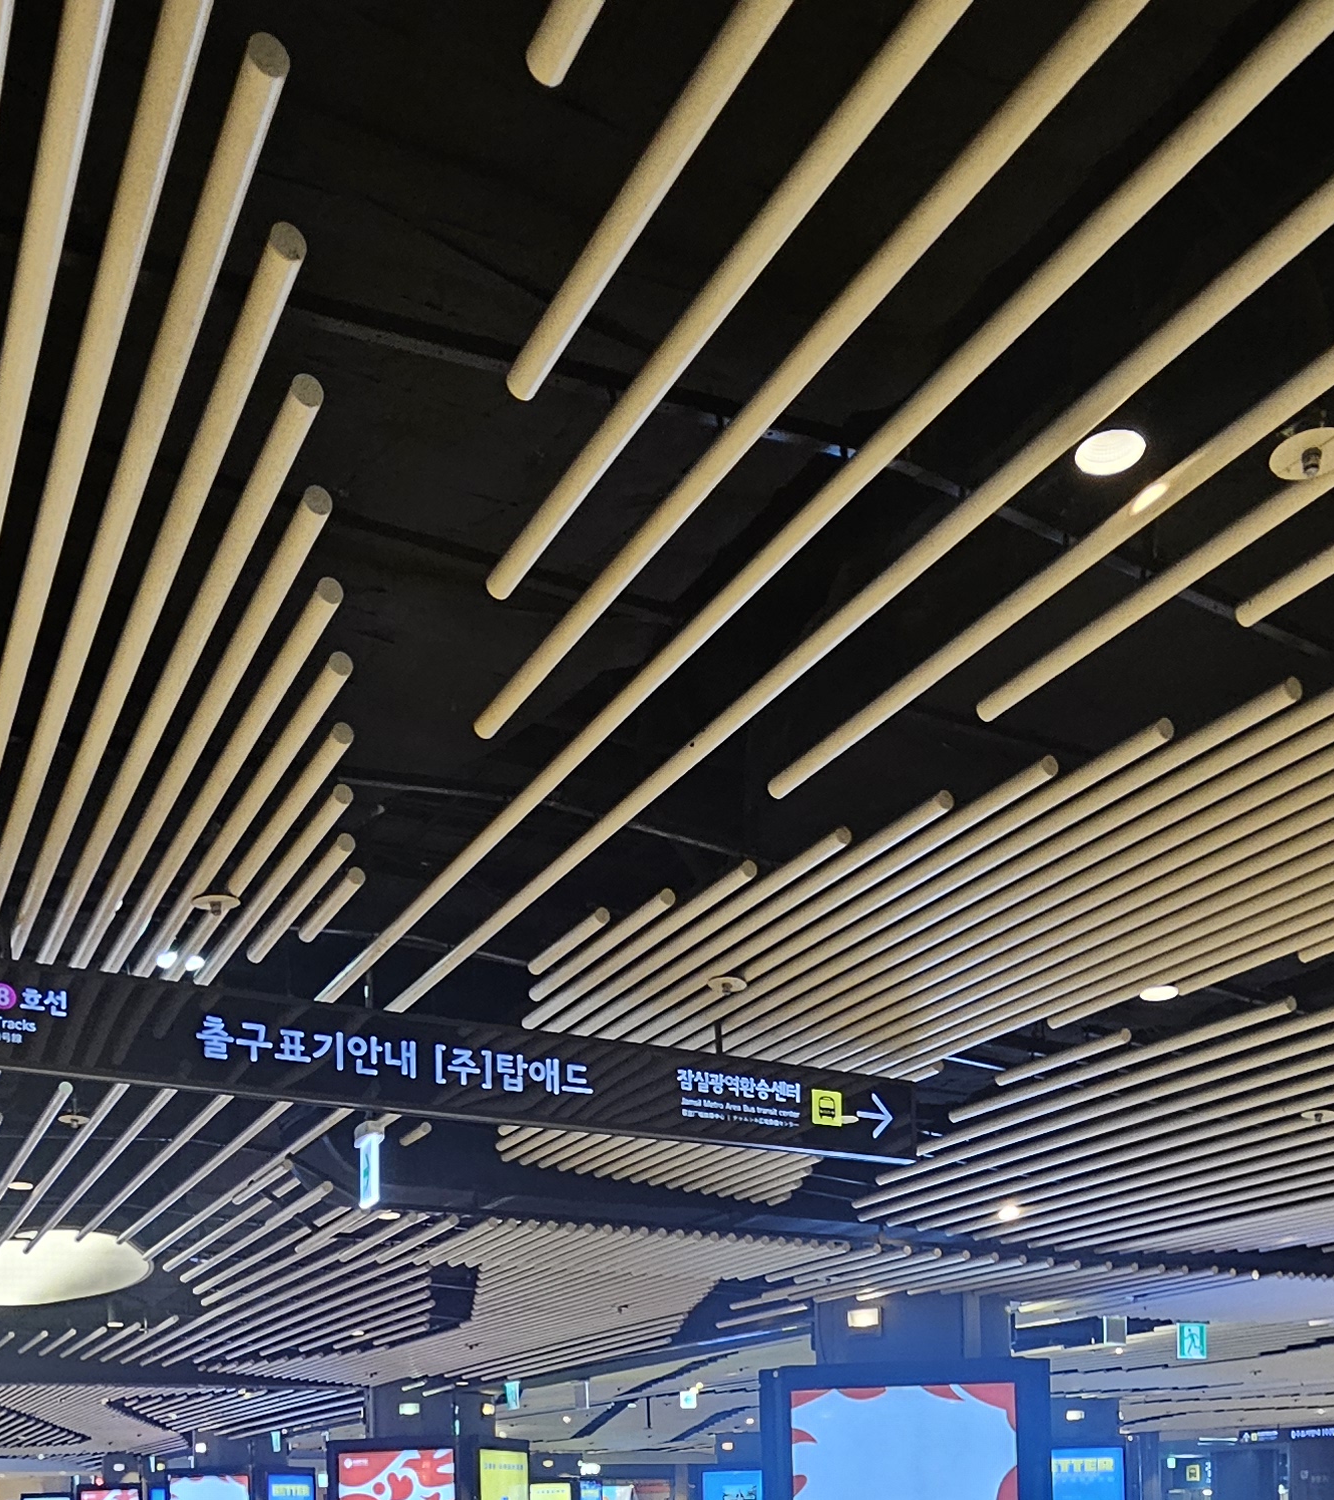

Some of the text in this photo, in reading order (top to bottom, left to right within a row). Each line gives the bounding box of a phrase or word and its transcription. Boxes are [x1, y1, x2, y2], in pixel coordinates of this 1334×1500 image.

[19, 987, 68, 1018] 호선
[195, 1014, 417, 1080] 출구표기안내
[676, 1068, 801, 1104] 잠실광역환승센터
